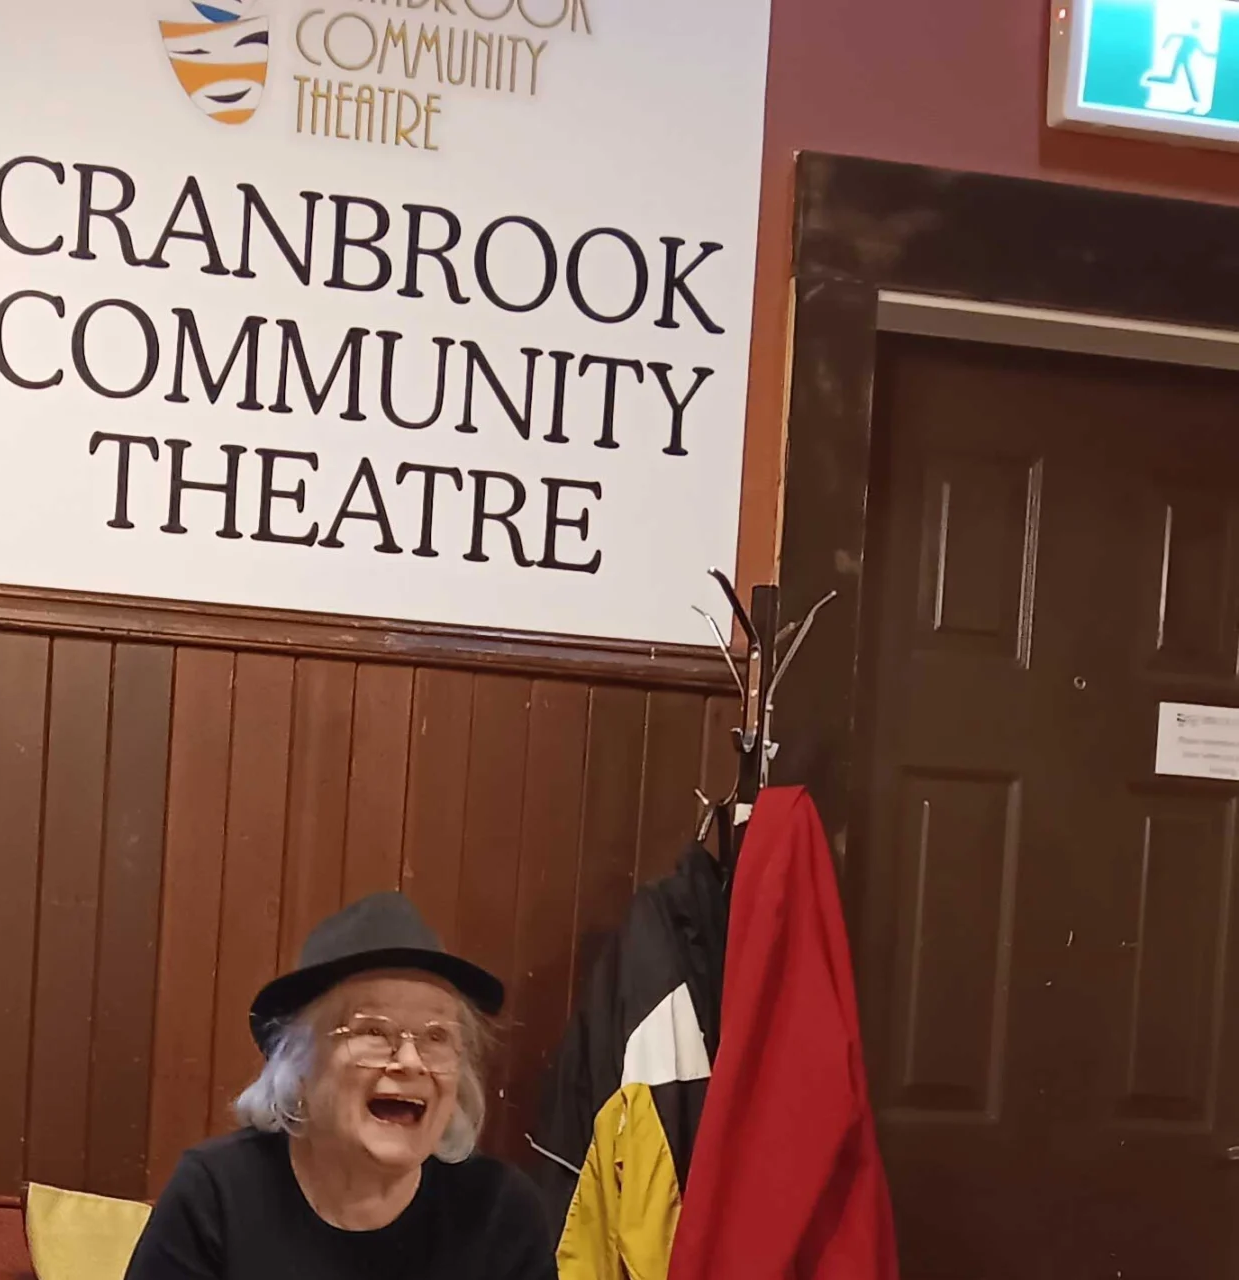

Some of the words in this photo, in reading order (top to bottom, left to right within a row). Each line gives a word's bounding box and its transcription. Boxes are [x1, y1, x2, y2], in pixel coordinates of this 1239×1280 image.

[296, 9, 548, 95] COMMUNITY
[293, 75, 441, 151] THEATRE
[89, 431, 603, 575] THEATRE
